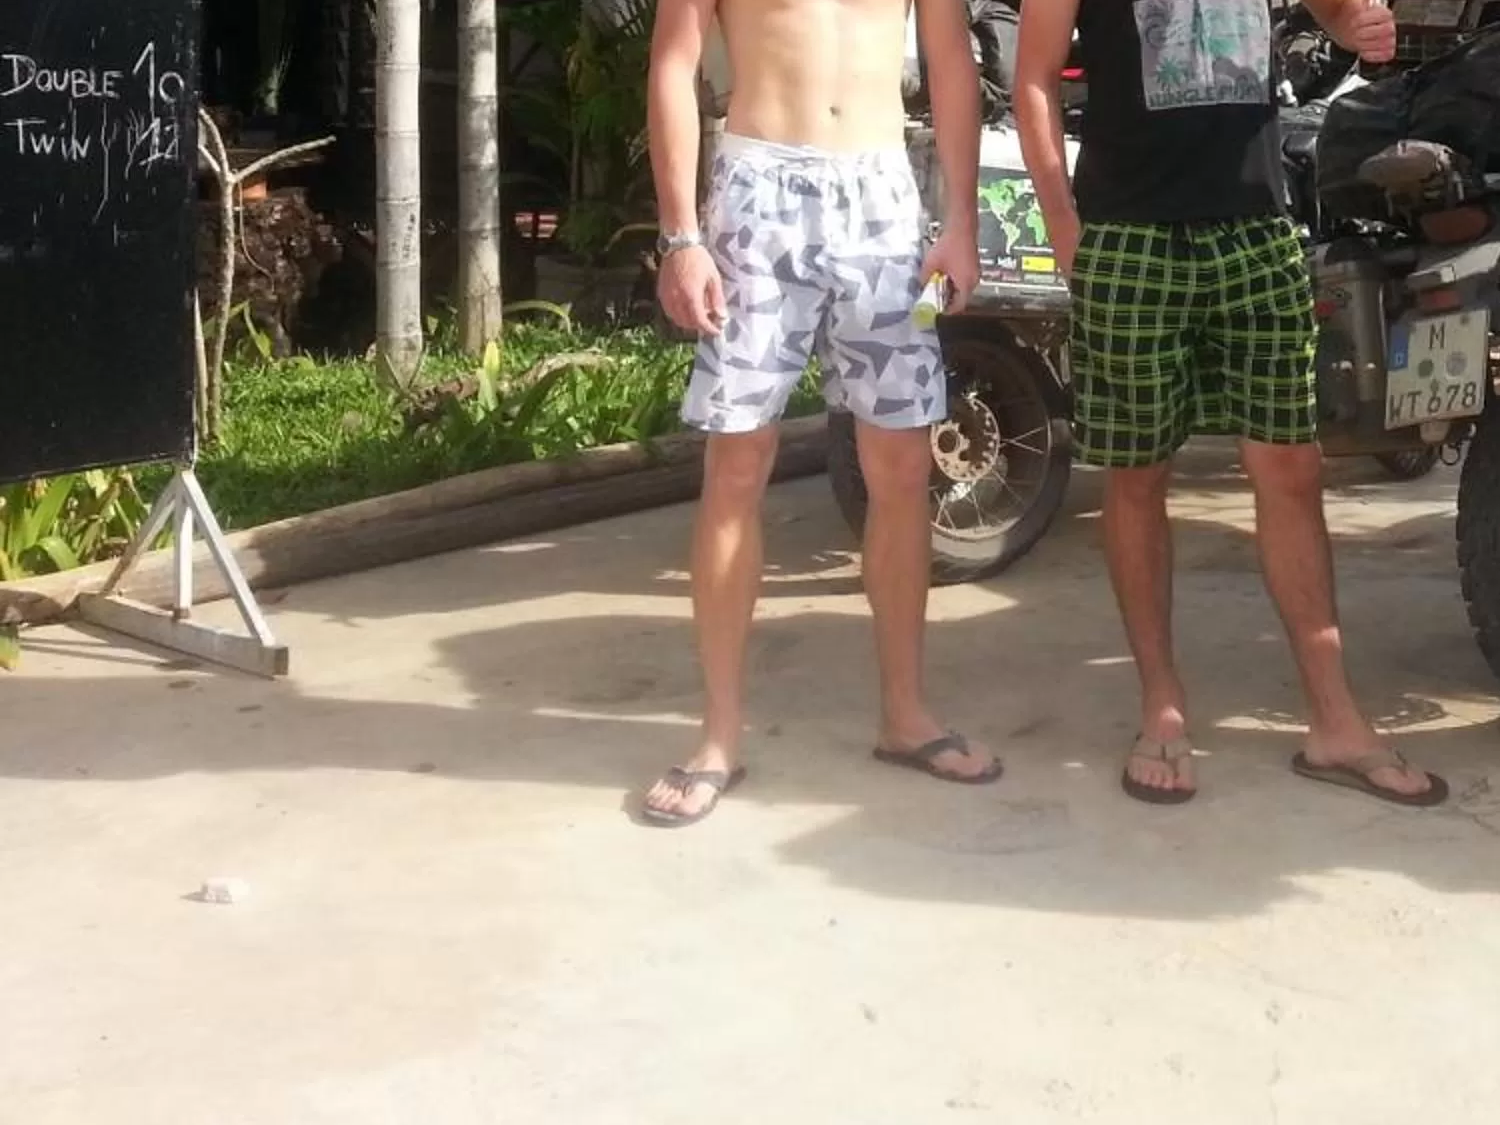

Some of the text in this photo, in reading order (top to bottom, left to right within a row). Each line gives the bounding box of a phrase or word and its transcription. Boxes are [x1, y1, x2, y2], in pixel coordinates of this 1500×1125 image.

[1428, 322, 1446, 351] M
[1389, 381, 1478, 422] WT 678
